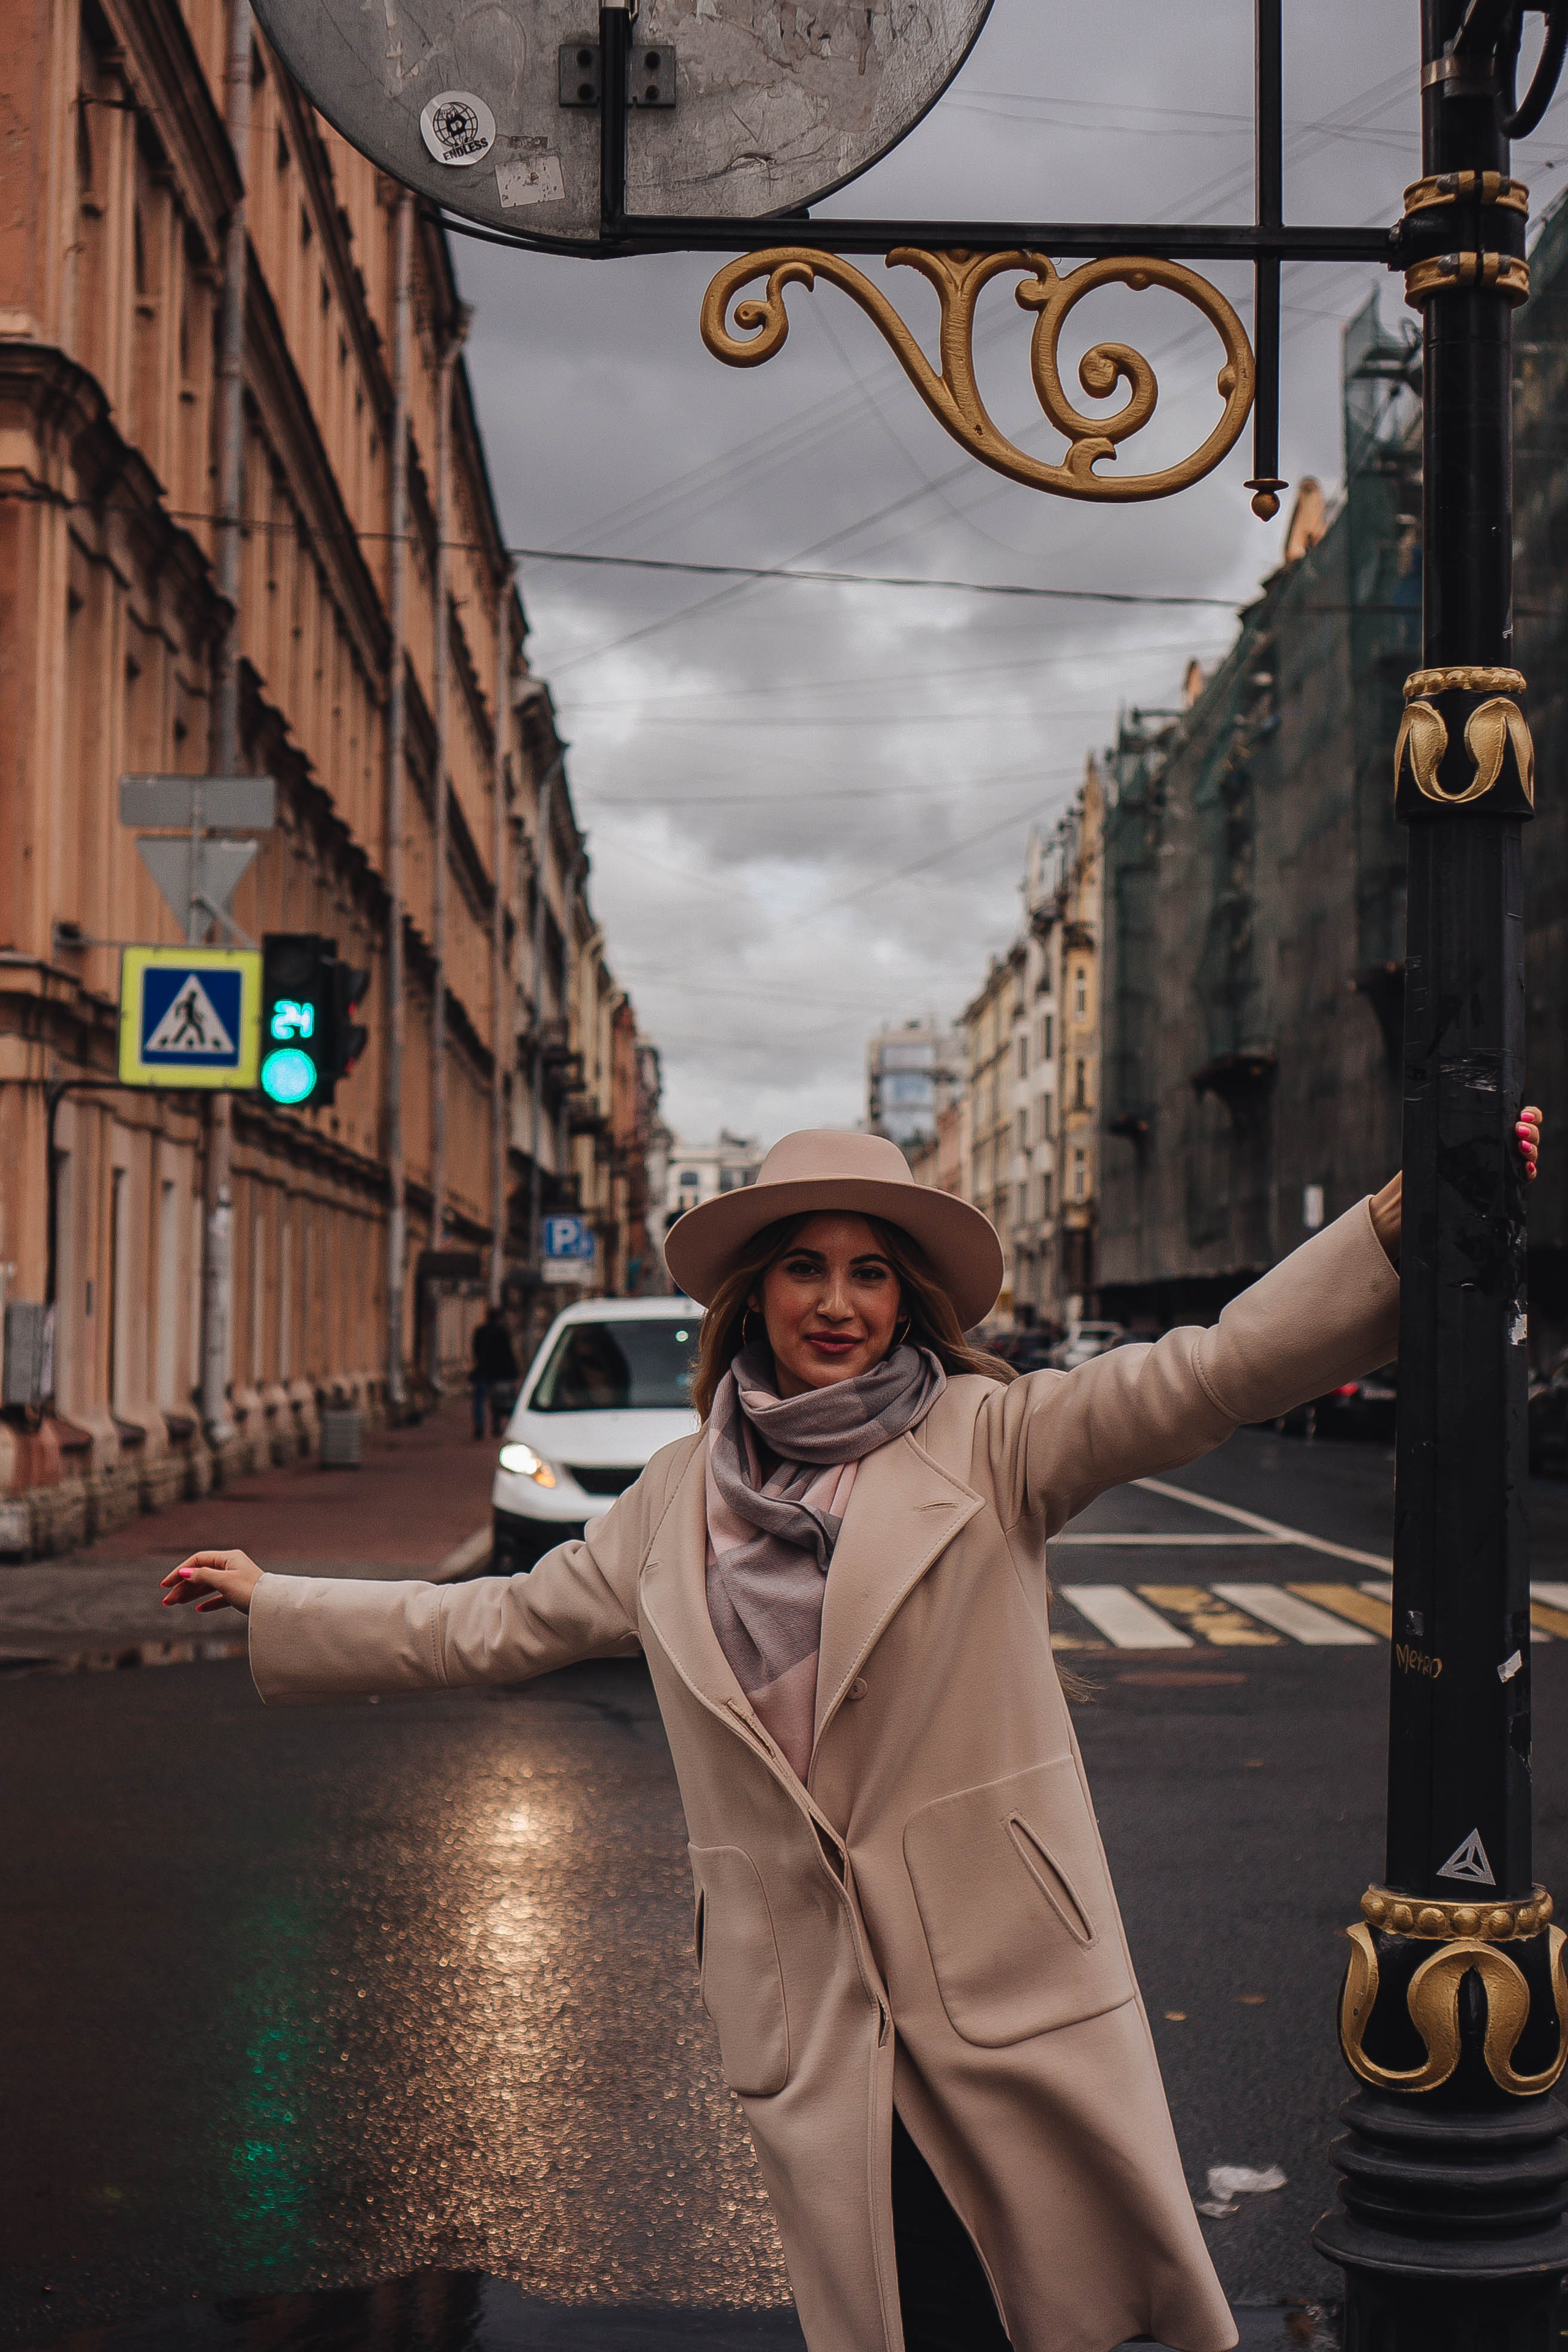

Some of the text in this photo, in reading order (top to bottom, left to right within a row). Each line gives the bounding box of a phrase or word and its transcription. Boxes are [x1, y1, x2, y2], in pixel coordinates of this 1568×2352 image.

[443, 137, 488, 160] ENDLESS
[272, 1000, 314, 1039] 24
[553, 1219, 578, 1253] P
